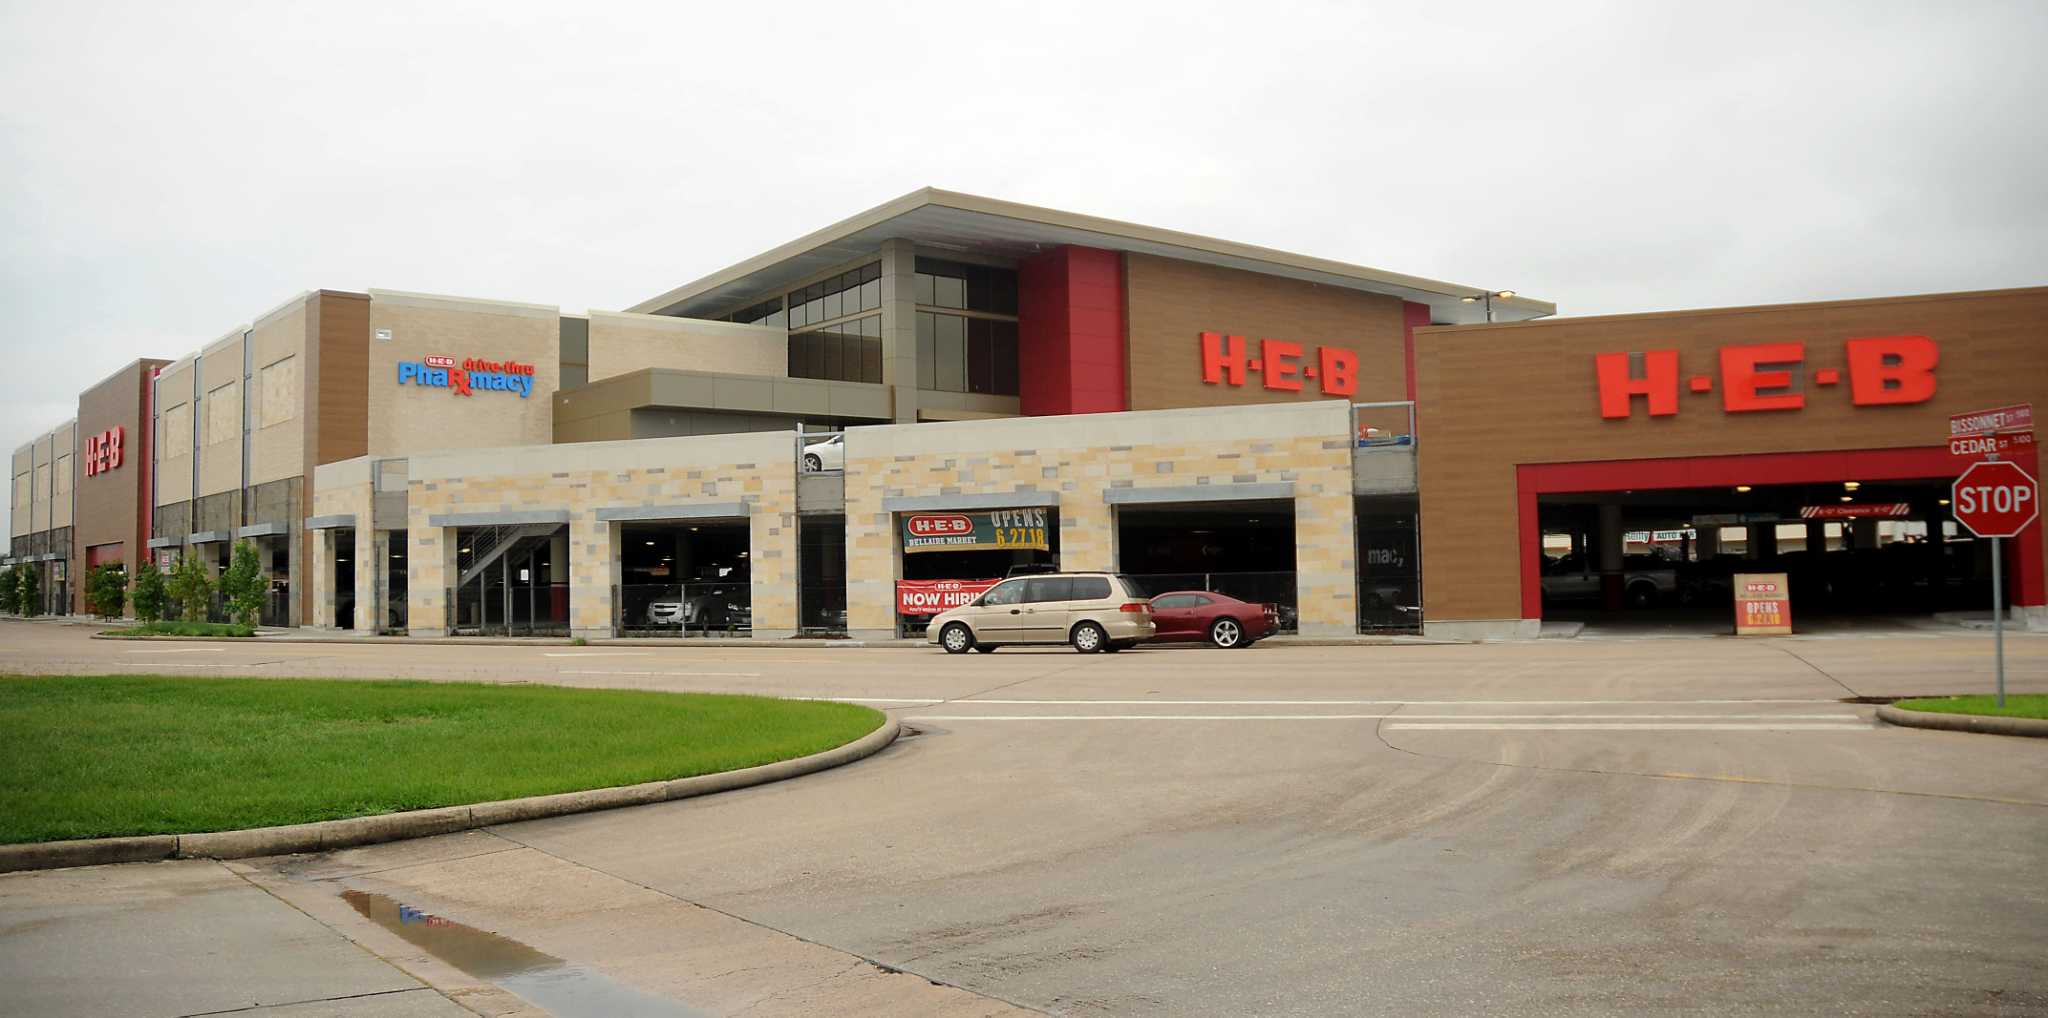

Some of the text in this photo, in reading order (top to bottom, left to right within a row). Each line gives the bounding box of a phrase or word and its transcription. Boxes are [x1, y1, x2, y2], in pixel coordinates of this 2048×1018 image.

[463, 358, 535, 376] drive-thru
[1951, 437, 1997, 455] CEDAR
[1959, 485, 2032, 514] STOP
[991, 509, 1045, 527] OPENS
[909, 536, 977, 547] BELLAIRE MARKET
[903, 592, 940, 606] NOW
